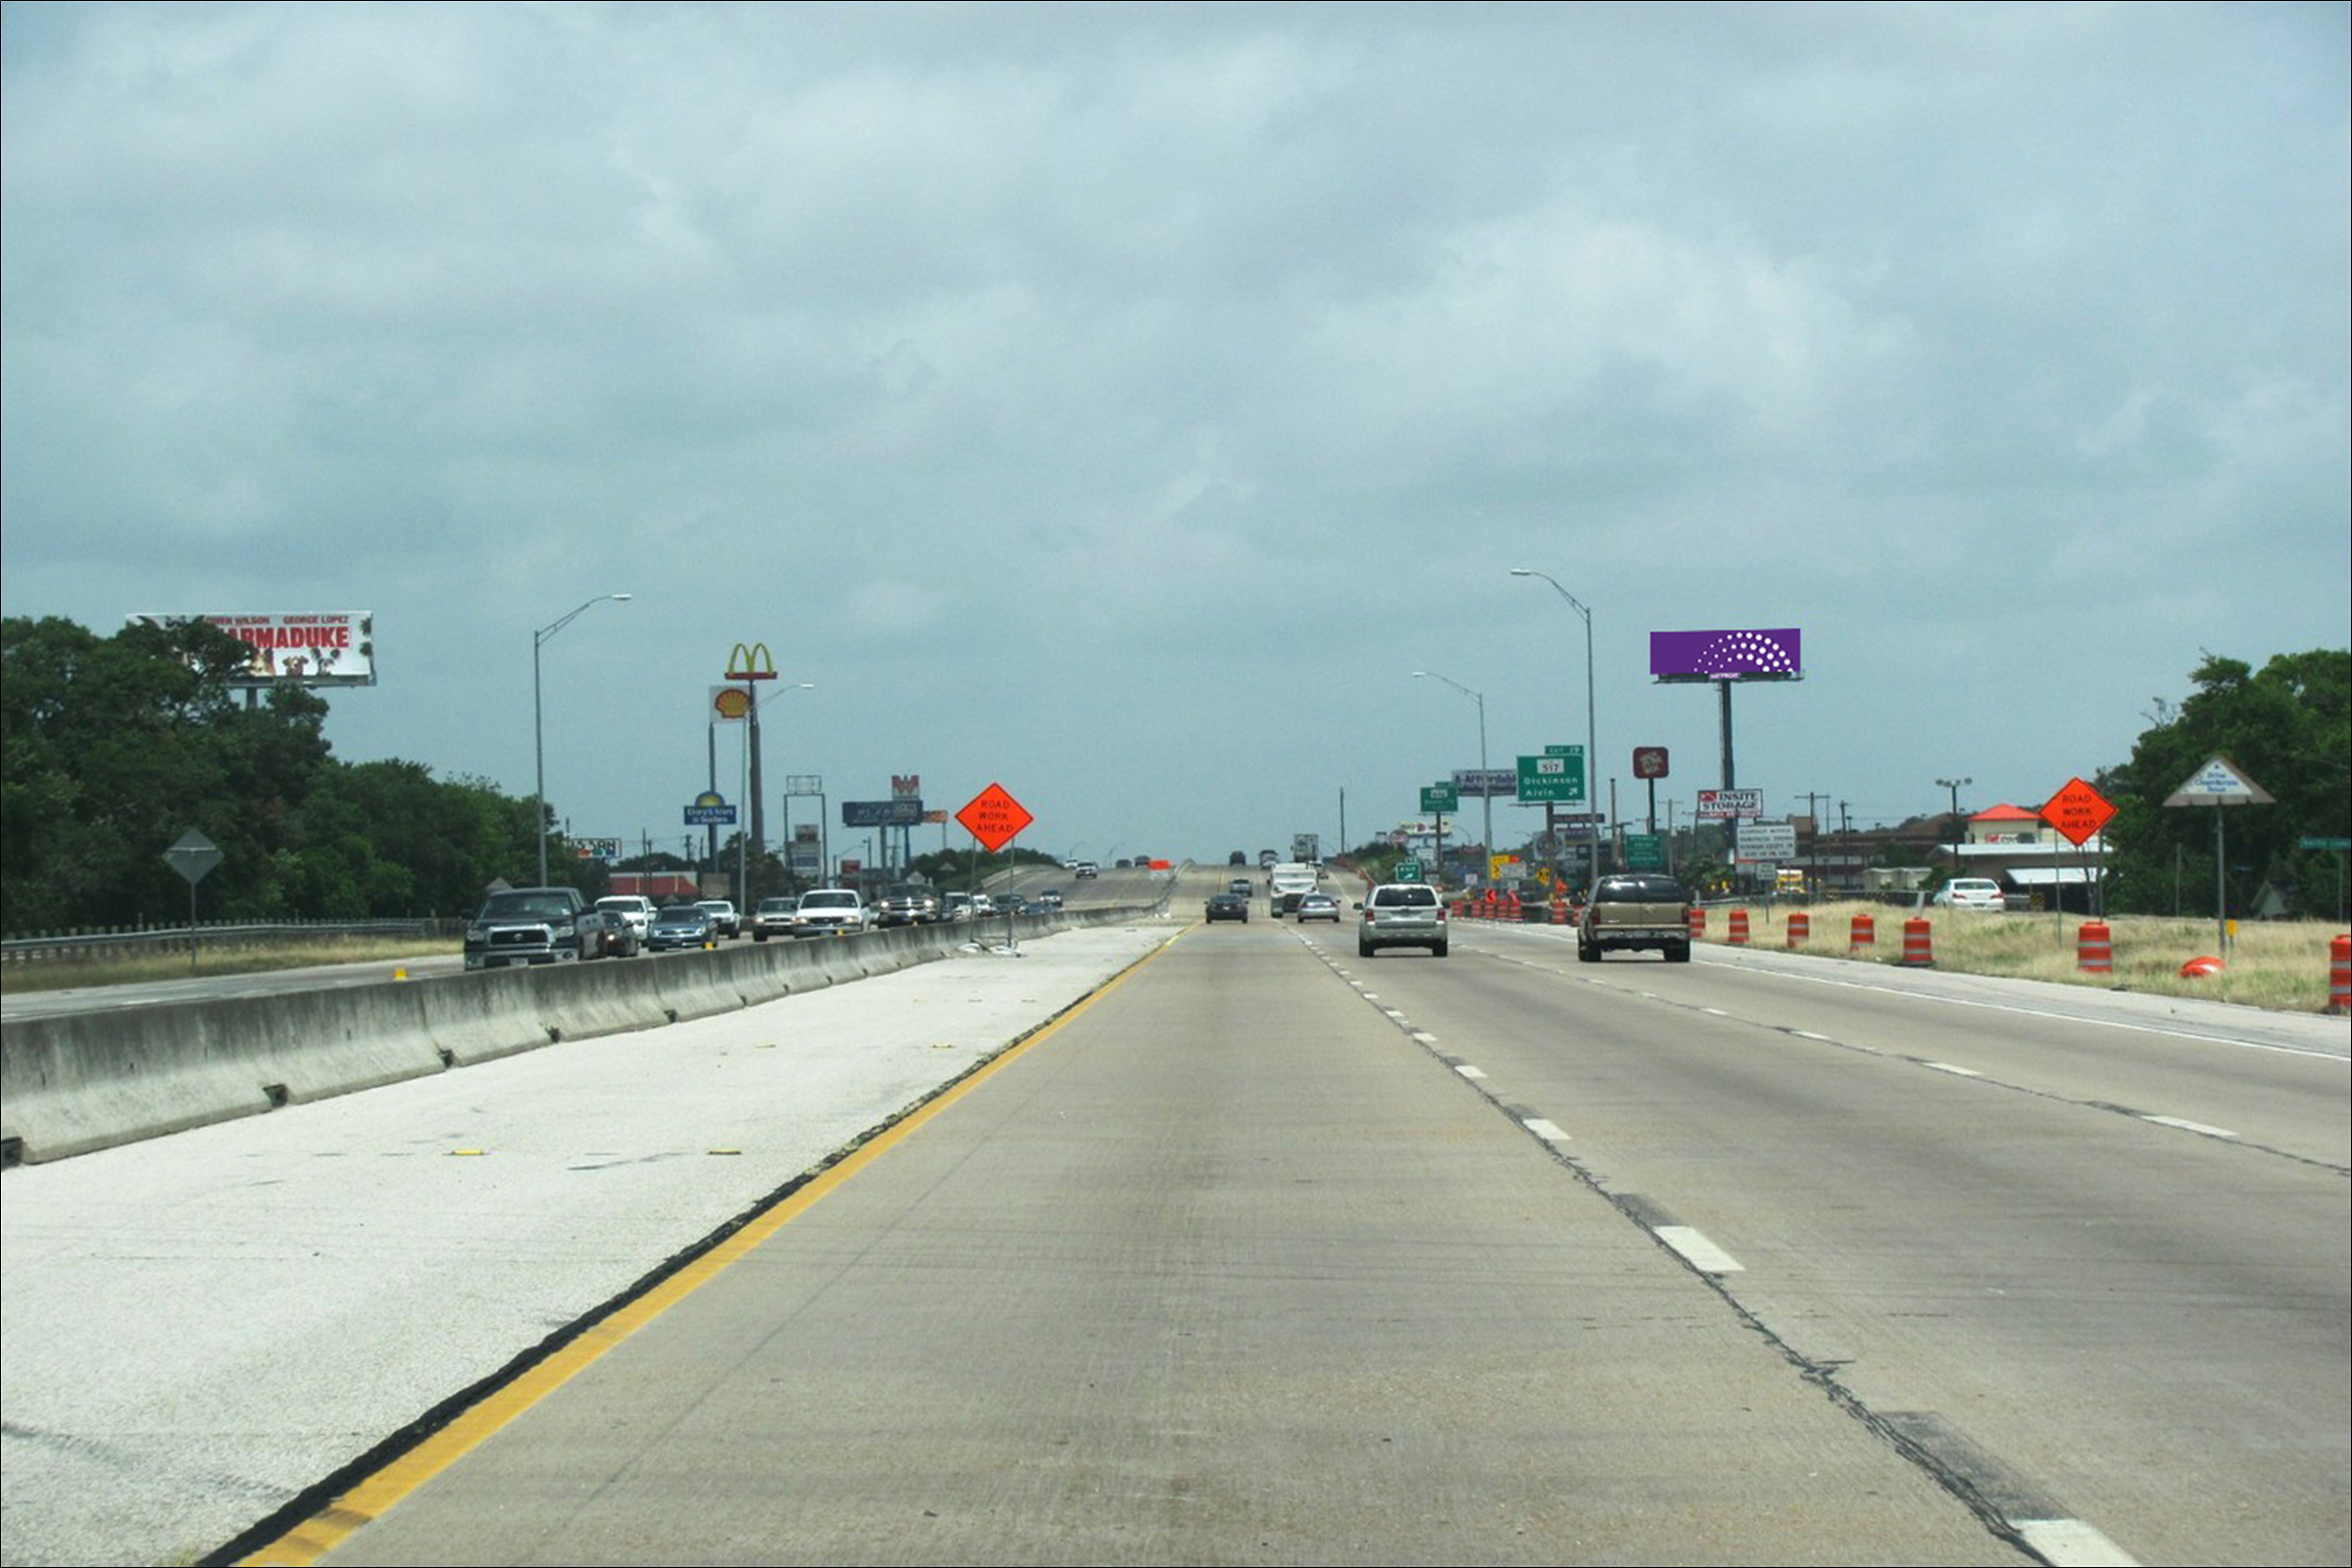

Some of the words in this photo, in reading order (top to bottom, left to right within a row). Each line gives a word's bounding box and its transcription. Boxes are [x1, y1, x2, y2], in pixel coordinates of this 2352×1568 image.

[236, 615, 270, 625] WILSON
[283, 615, 318, 624] GEORGE
[321, 615, 349, 624] LOPEZ
[226, 626, 349, 648] ARMADUKE
[1542, 763, 1560, 772] 517
[1523, 776, 1579, 785] Dickinson
[1525, 788, 1555, 797] Alvin
[1718, 792, 1757, 801] INSITE
[981, 799, 1010, 809] ROAD
[2062, 795, 2091, 804] ROAD
[1702, 802, 1756, 810] STORAGE
[979, 811, 1008, 821] WORK
[976, 824, 1014, 833] AHEAD
